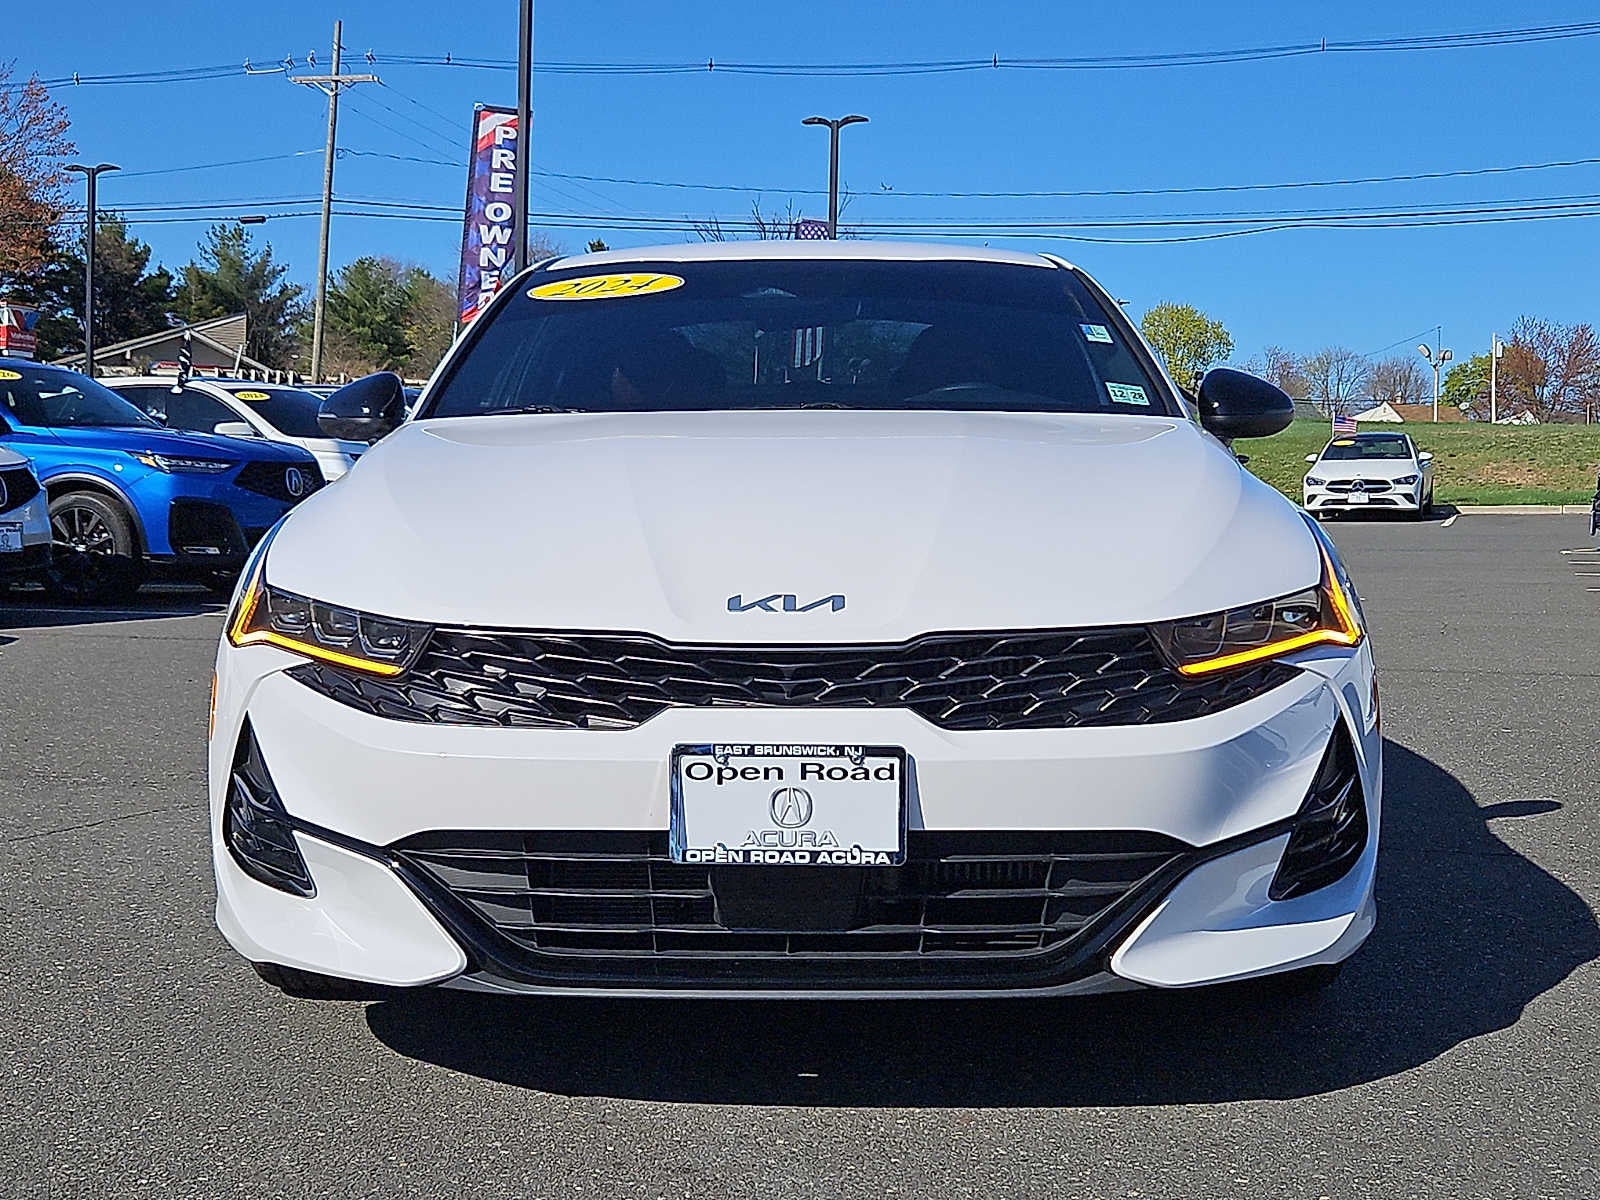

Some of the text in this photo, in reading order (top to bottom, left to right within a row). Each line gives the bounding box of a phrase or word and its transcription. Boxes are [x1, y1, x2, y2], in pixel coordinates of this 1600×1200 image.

[490, 125, 517, 193] PRE
[548, 276, 664, 297] 2024
[1111, 389, 1126, 398] 12
[727, 594, 846, 612] KIA
[714, 745, 863, 756] EAST BRUNSWICK, NJ
[685, 762, 896, 785] Open Road
[740, 830, 840, 848] ACURA
[685, 850, 892, 865] OPEN ROAD ACURA
